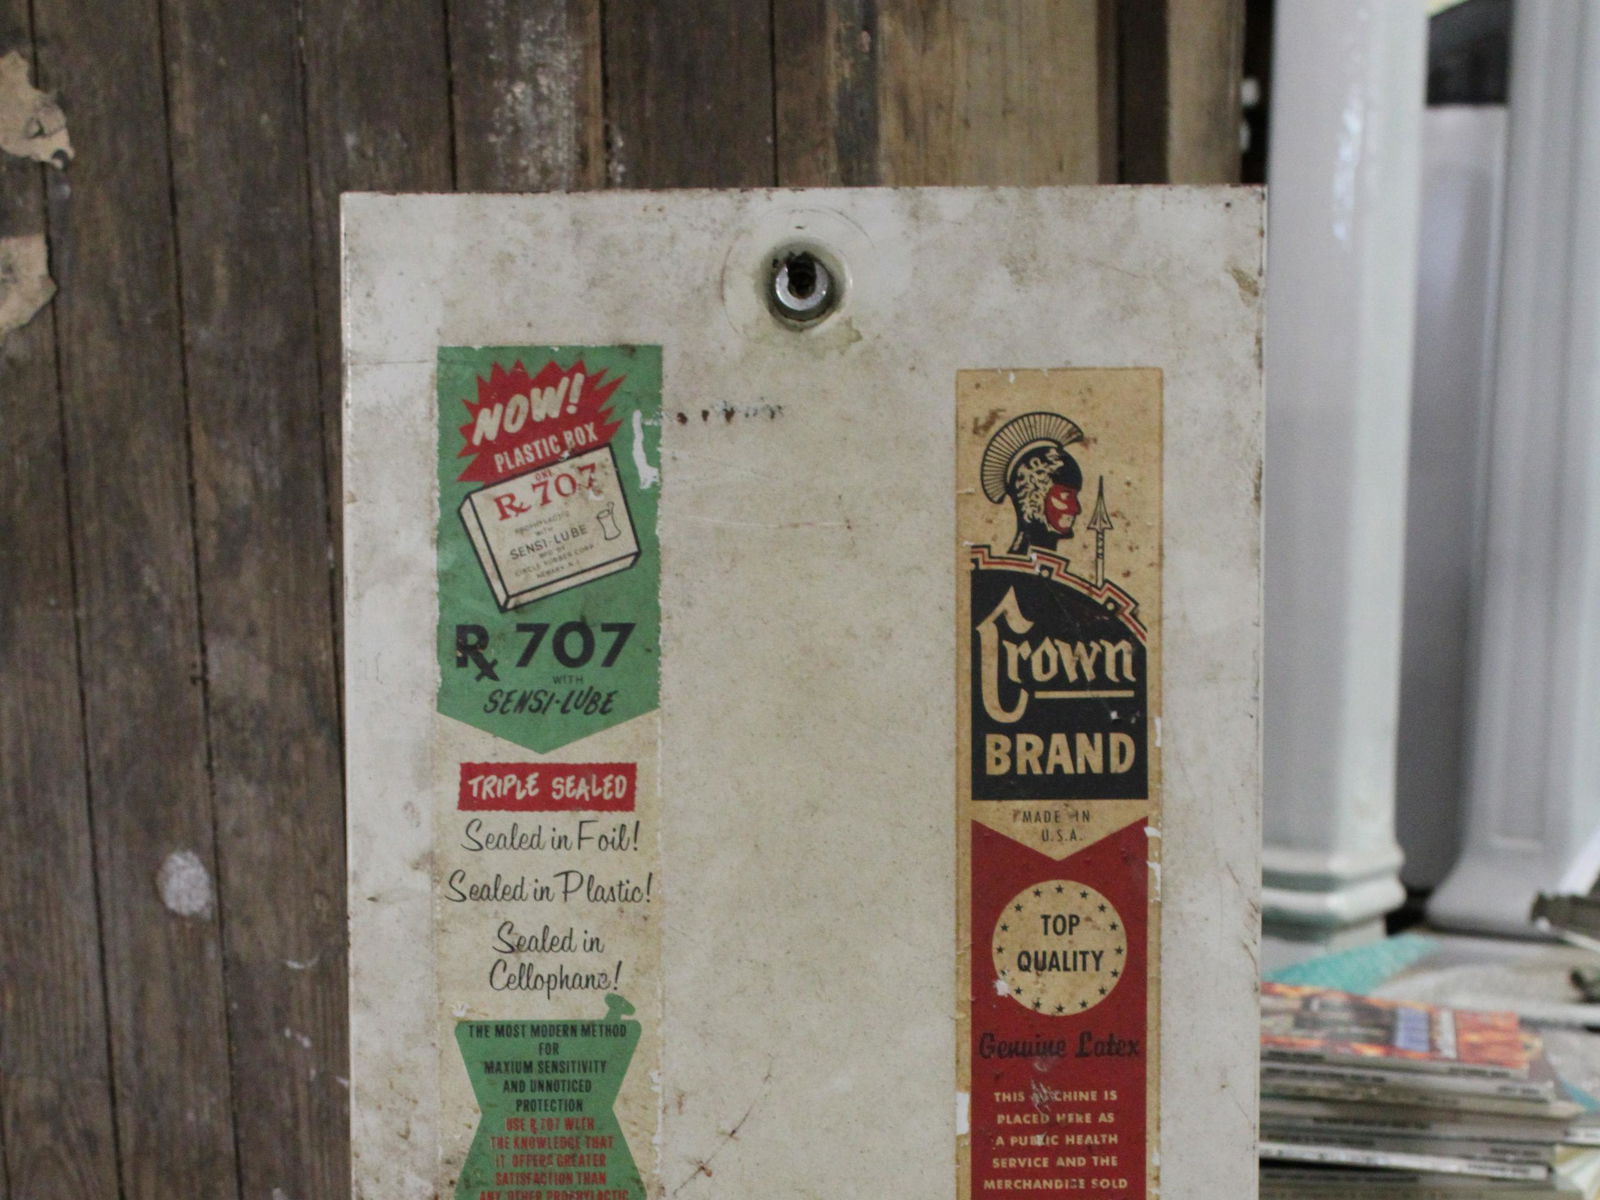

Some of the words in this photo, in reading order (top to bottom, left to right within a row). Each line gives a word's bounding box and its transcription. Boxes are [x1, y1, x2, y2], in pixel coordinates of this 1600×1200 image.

[472, 373, 585, 446] NOW!
[494, 434, 562, 473] PLASTIC
[564, 422, 598, 449] BOX
[515, 621, 636, 668] 707
[976, 585, 1136, 723] Crown
[552, 675, 584, 685] WITH
[483, 685, 618, 715] SENSI-LUBE
[986, 733, 1135, 775] BRAND
[468, 772, 540, 800] TRIPLE
[551, 774, 627, 801] SEALED
[1021, 810, 1060, 823] MADE
[1076, 810, 1090, 822] IN
[460, 818, 545, 851] Sealed
[551, 828, 573, 850] in
[577, 819, 640, 851] Foil!
[1042, 829, 1083, 842] U.S.A.
[444, 869, 528, 902] Sealed
[533, 879, 555, 901] in
[553, 870, 653, 904] Plastic!
[1041, 914, 1080, 936] TOP
[492, 920, 577, 954] Sealed
[583, 929, 605, 952] in
[1017, 951, 1104, 972] QUALITY
[489, 958, 622, 1000] Cellophane!
[468, 1024, 491, 1039] THE
[495, 1024, 526, 1038] MOST
[530, 1024, 577, 1038] MODERN
[581, 1024, 627, 1038] METHOD
[538, 1042, 559, 1056] FOR
[979, 1032, 1066, 1059] Genuine
[1076, 1031, 1139, 1058] Latex
[537, 1060, 607, 1074] SENSITIVITY
[503, 1080, 526, 1094] AND
[530, 1080, 592, 1093] UNNOTICED
[994, 1092, 1025, 1103] THIS
[1104, 1090, 1118, 1100] IS
[516, 1099, 583, 1113] PROTECTION
[505, 1117, 525, 1131] USE
[997, 1113, 1050, 1124] PLACED
[1056, 1113, 1092, 1123] HERE
[1098, 1112, 1115, 1123] AS
[491, 1136, 510, 1149] THE
[513, 1136, 581, 1150] KNOWLEDGE
[585, 1135, 614, 1149] THAT
[995, 1136, 1005, 1146] A
[1065, 1134, 1118, 1145] HEALTH
[512, 1154, 553, 1167] OFFERS
[556, 1153, 606, 1167] GREATER
[992, 1157, 1049, 1169] SERVICE
[1056, 1157, 1087, 1167] AND
[1092, 1156, 1118, 1167] THE
[496, 1172, 573, 1186] SATISFACTION
[576, 1171, 606, 1185] THAN
[983, 1179, 1085, 1190] MERCHANDISE
[1091, 1178, 1128, 1189] SOLD
